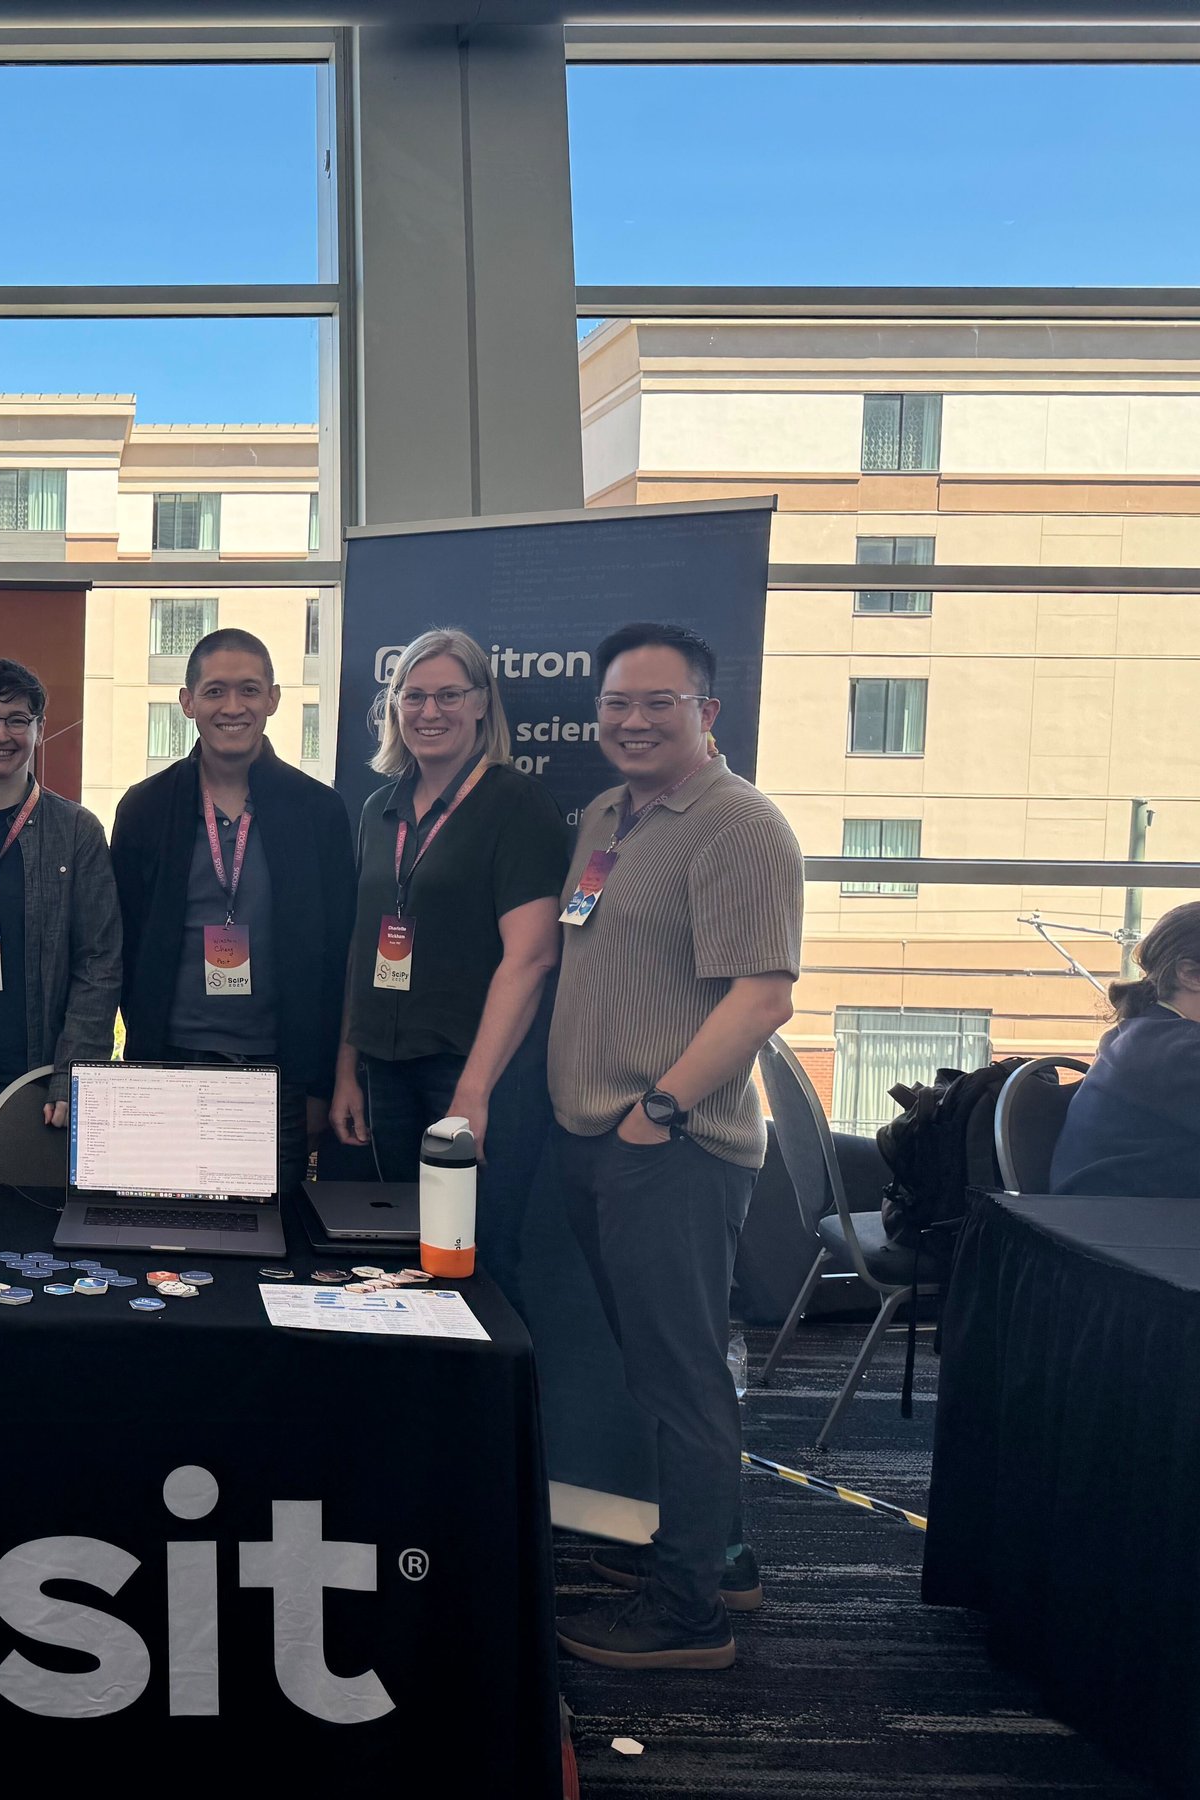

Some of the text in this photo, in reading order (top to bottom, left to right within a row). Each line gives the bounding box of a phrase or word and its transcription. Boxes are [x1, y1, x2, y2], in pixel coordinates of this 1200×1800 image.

[489, 644, 591, 679] itron
[516, 716, 600, 742] scien
[228, 977, 249, 985] SciPy
[392, 971, 409, 980] SciPy
